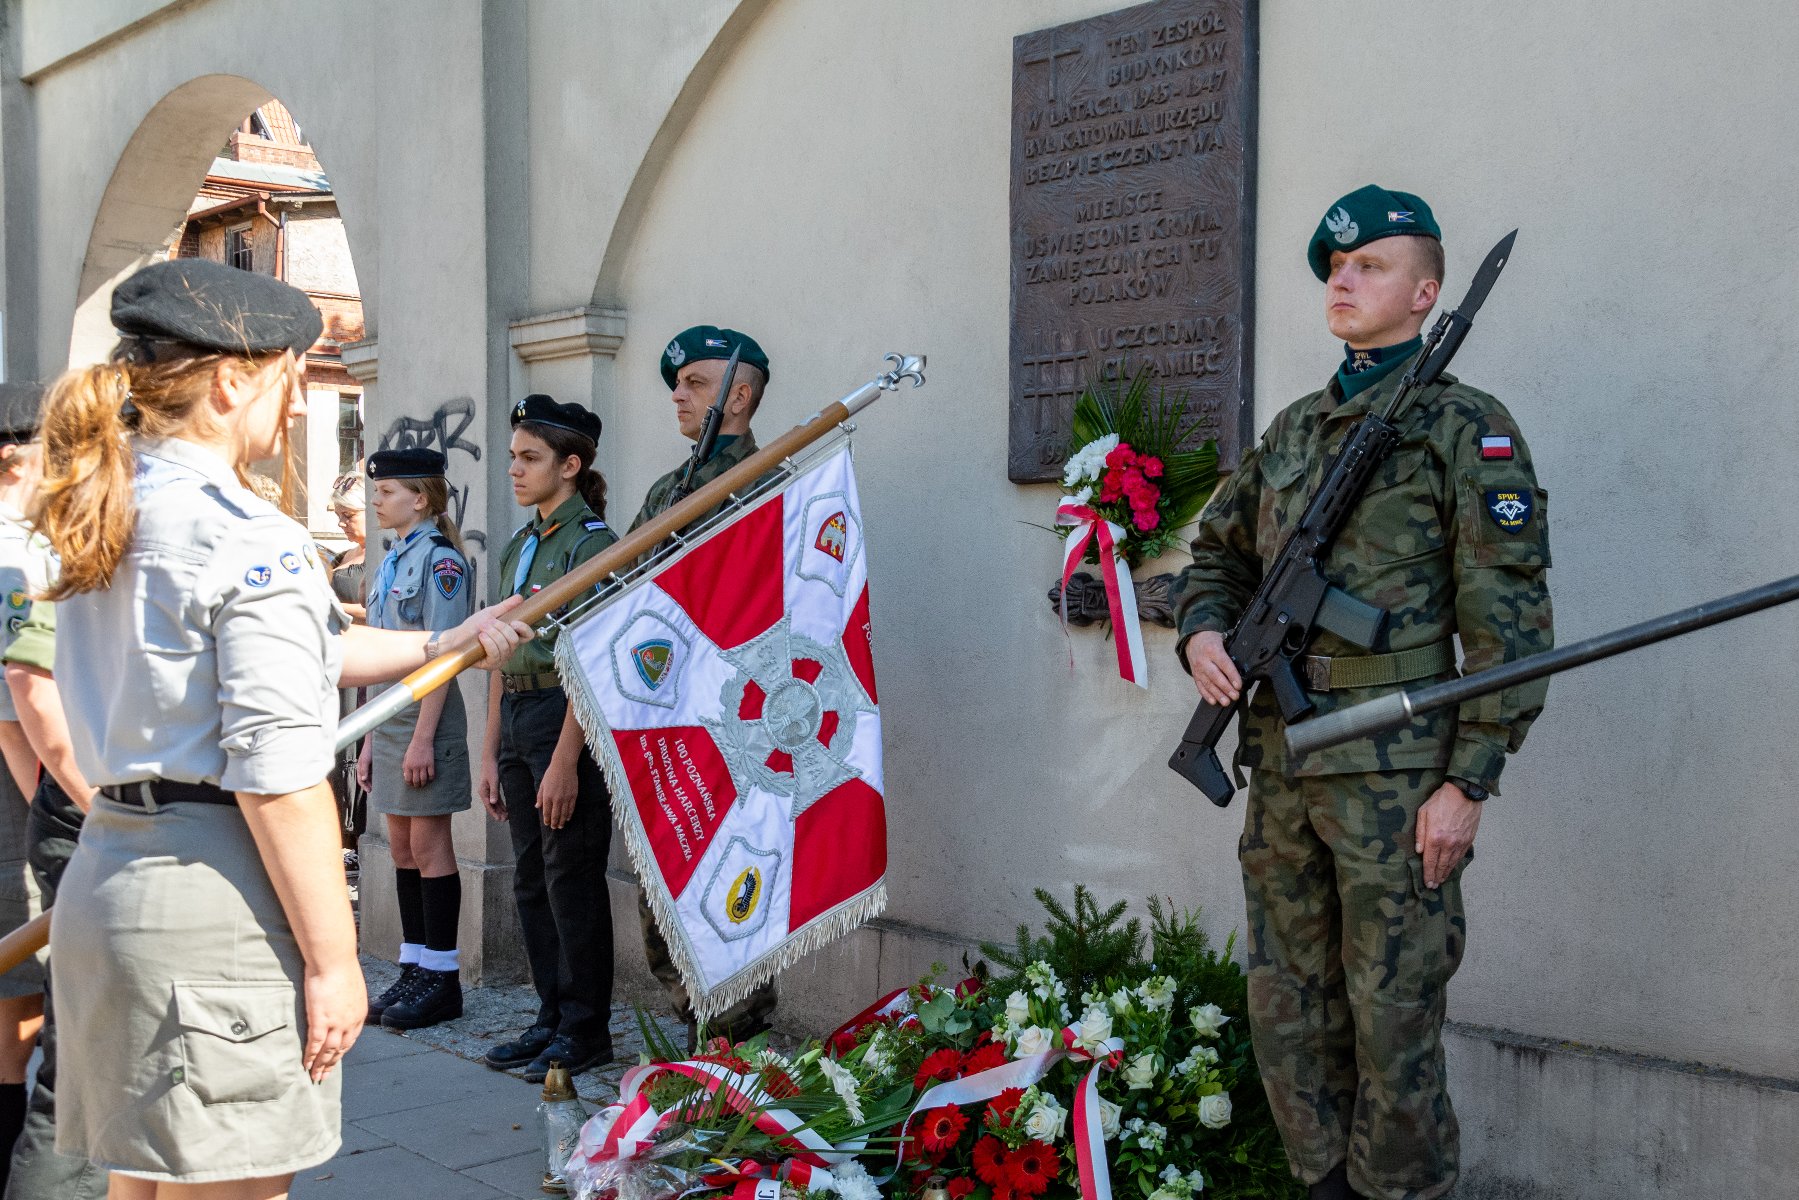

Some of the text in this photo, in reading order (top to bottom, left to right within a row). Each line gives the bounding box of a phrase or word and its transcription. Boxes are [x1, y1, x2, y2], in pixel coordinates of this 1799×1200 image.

[1106, 31, 1147, 58] TEN
[1028, 110, 1045, 131] W
[1050, 92, 1132, 127] LATACH
[1154, 100, 1223, 135] URZĘDU
[1075, 190, 1163, 223] MIEJSCE
[1189, 238, 1220, 263] TU
[657, 737, 705, 841] DRUŻYNA HARCERZY
[674, 738, 717, 821] 100 POZNAŃSKA
[651, 769, 678, 825] STANISŁAWA
[674, 824, 693, 862] MACZKA
